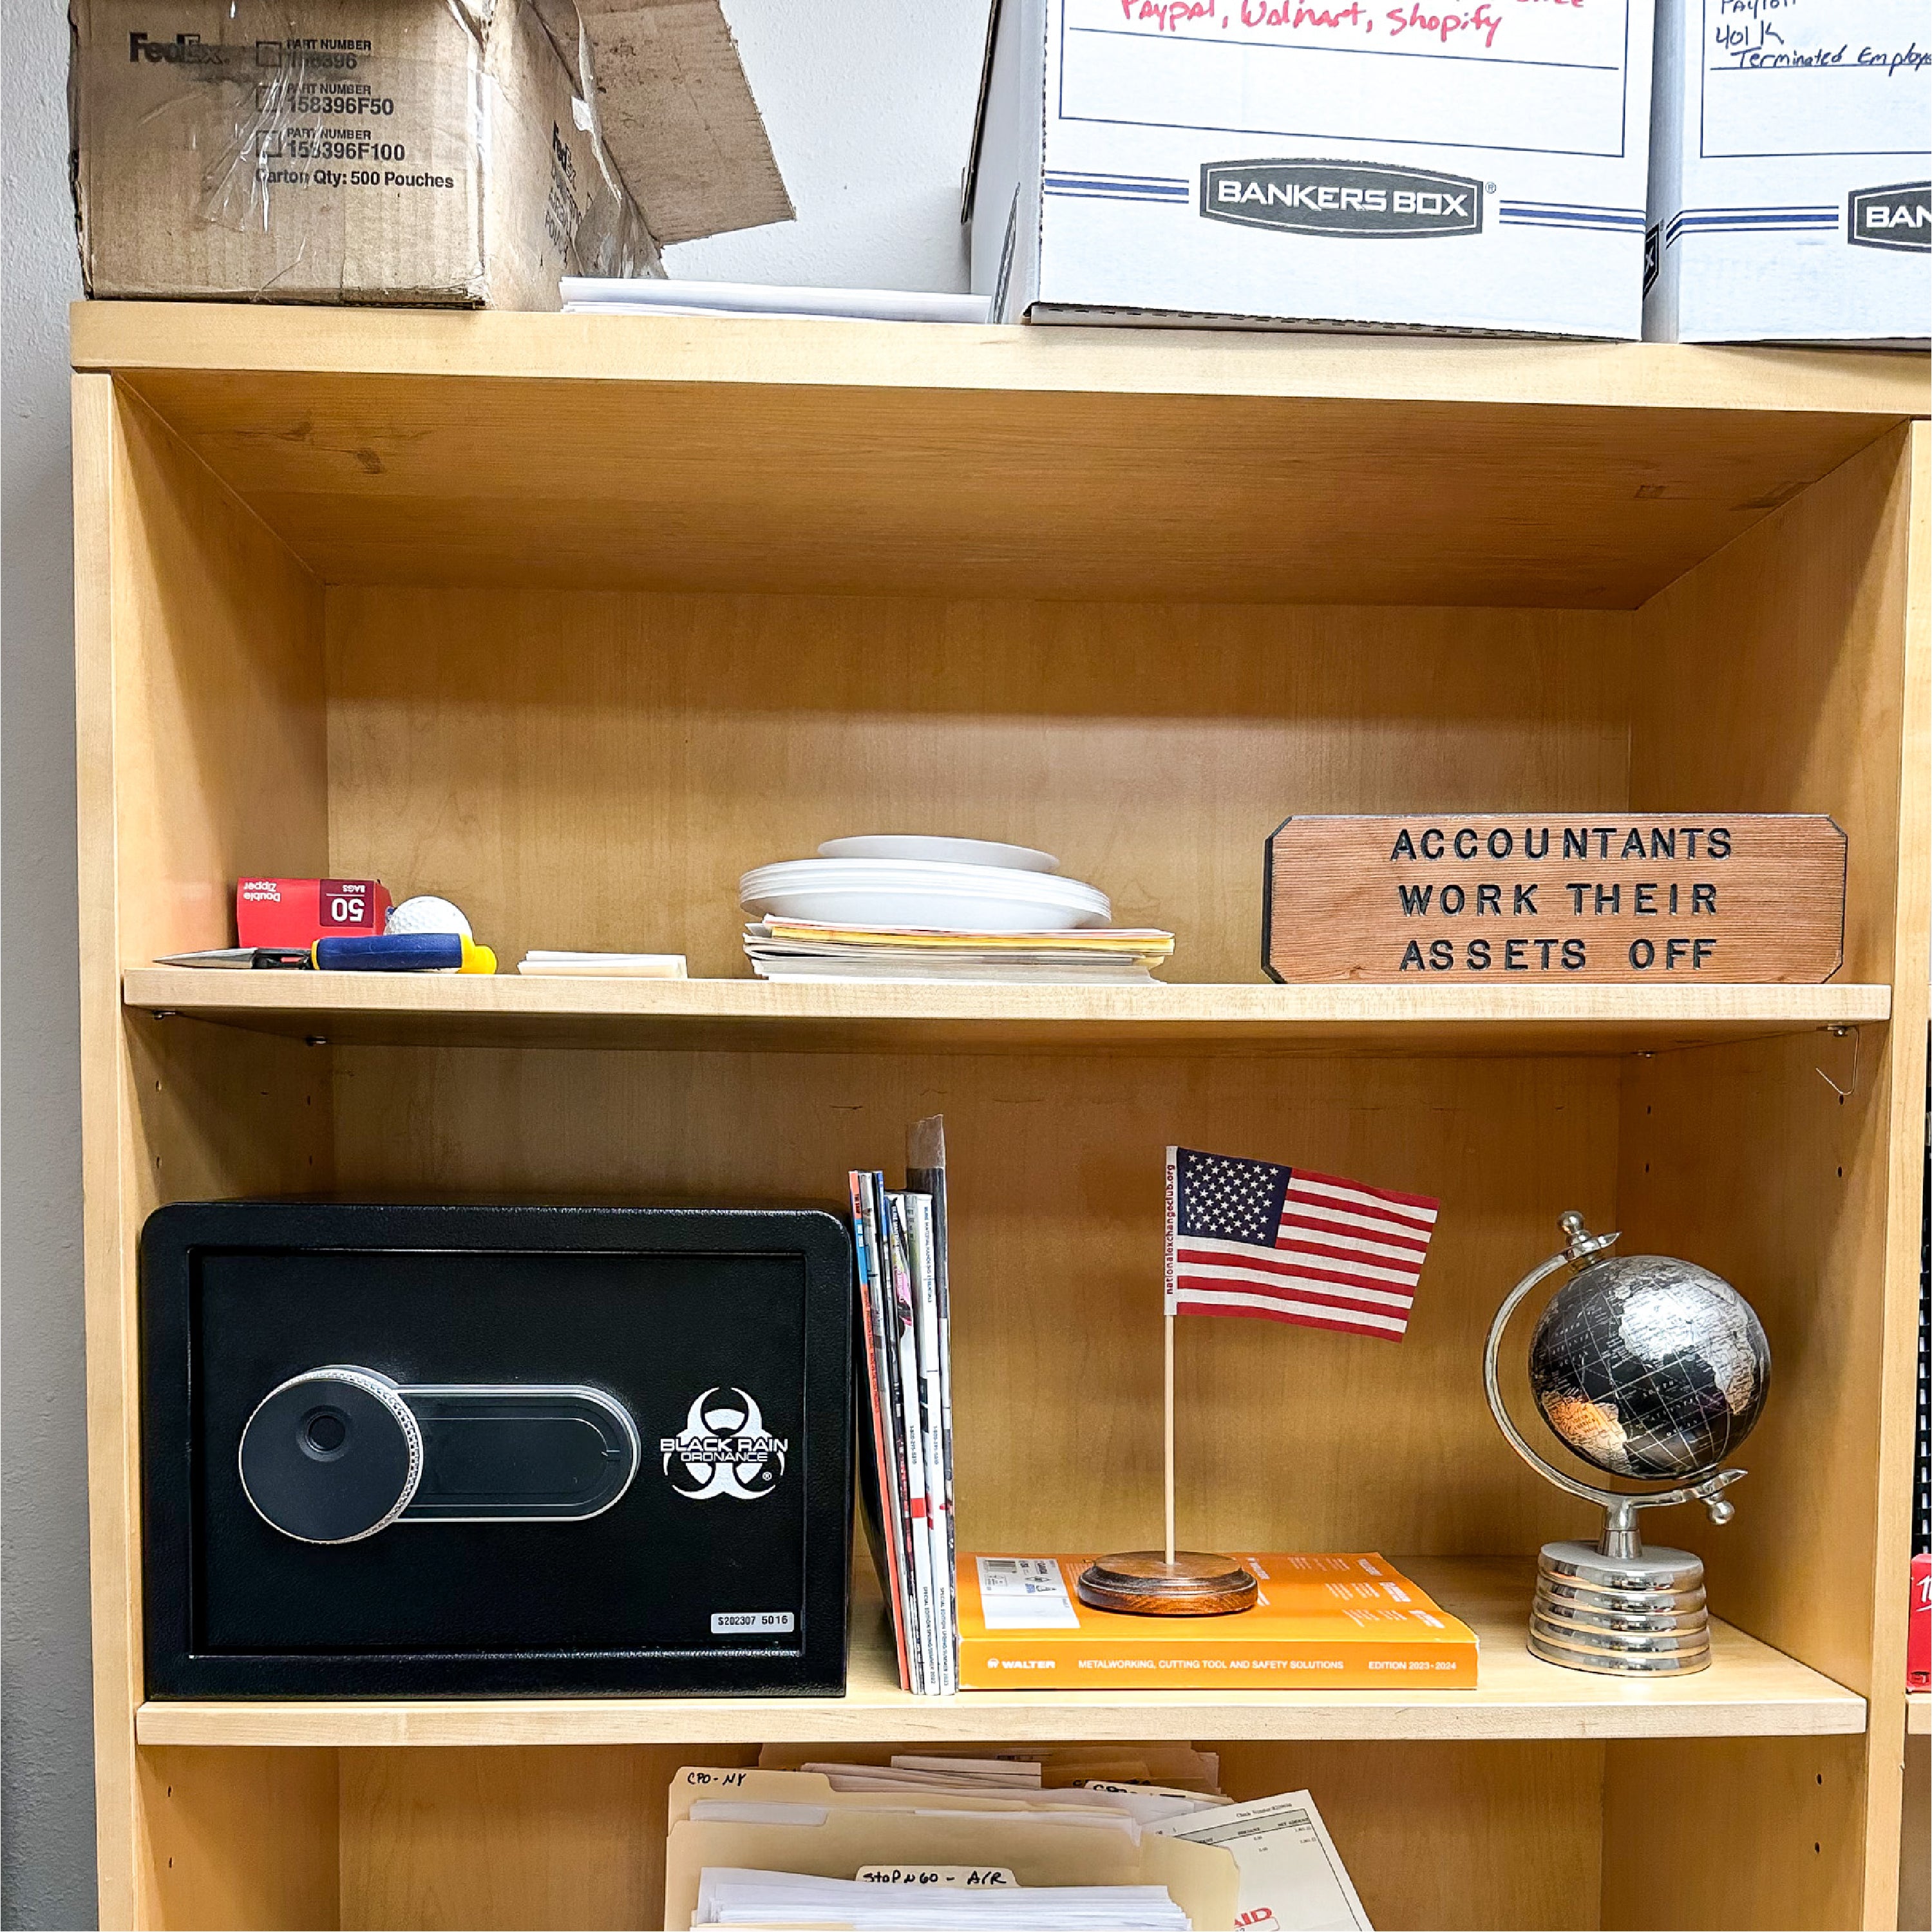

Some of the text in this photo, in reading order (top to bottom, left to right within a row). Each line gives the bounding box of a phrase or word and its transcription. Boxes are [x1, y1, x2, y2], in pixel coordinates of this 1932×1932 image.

[287, 39, 372, 50] PART NUMBER
[1730, 44, 1848, 68] Terminated
[287, 82, 372, 95] PART NUMBER
[287, 97, 395, 115] 158396F50
[320, 129, 372, 140] NUMBER
[287, 140, 406, 161] 158396F100
[256, 169, 455, 189] Carton Qty: 500 Pouches
[1217, 180, 1468, 217] BANKERS BOX
[1390, 827, 1734, 862] ACCOUNTANTS
[243, 881, 277, 892] Zipper
[343, 884, 366, 893] BAGS
[243, 892, 281, 902] Double
[1397, 882, 1719, 918] WORK THEIR
[331, 898, 365, 922] 50
[1398, 938, 1718, 972] ASSETS OFF
[1165, 1164, 1176, 1294] nationalexchangeclub.org
[660, 1438, 788, 1452] BLACK RAIN
[681, 1452, 769, 1462] ORDNANCE
[761, 1615, 788, 1625] 5016
[1001, 1660, 1056, 1669] WALTER
[1078, 1660, 1344, 1670] METALWORKING, CUTTING TOOL AND SAFETY SOLUTIONS
[1368, 1661, 1407, 1670] EDITION
[967, 1870, 1007, 1885] A/R
